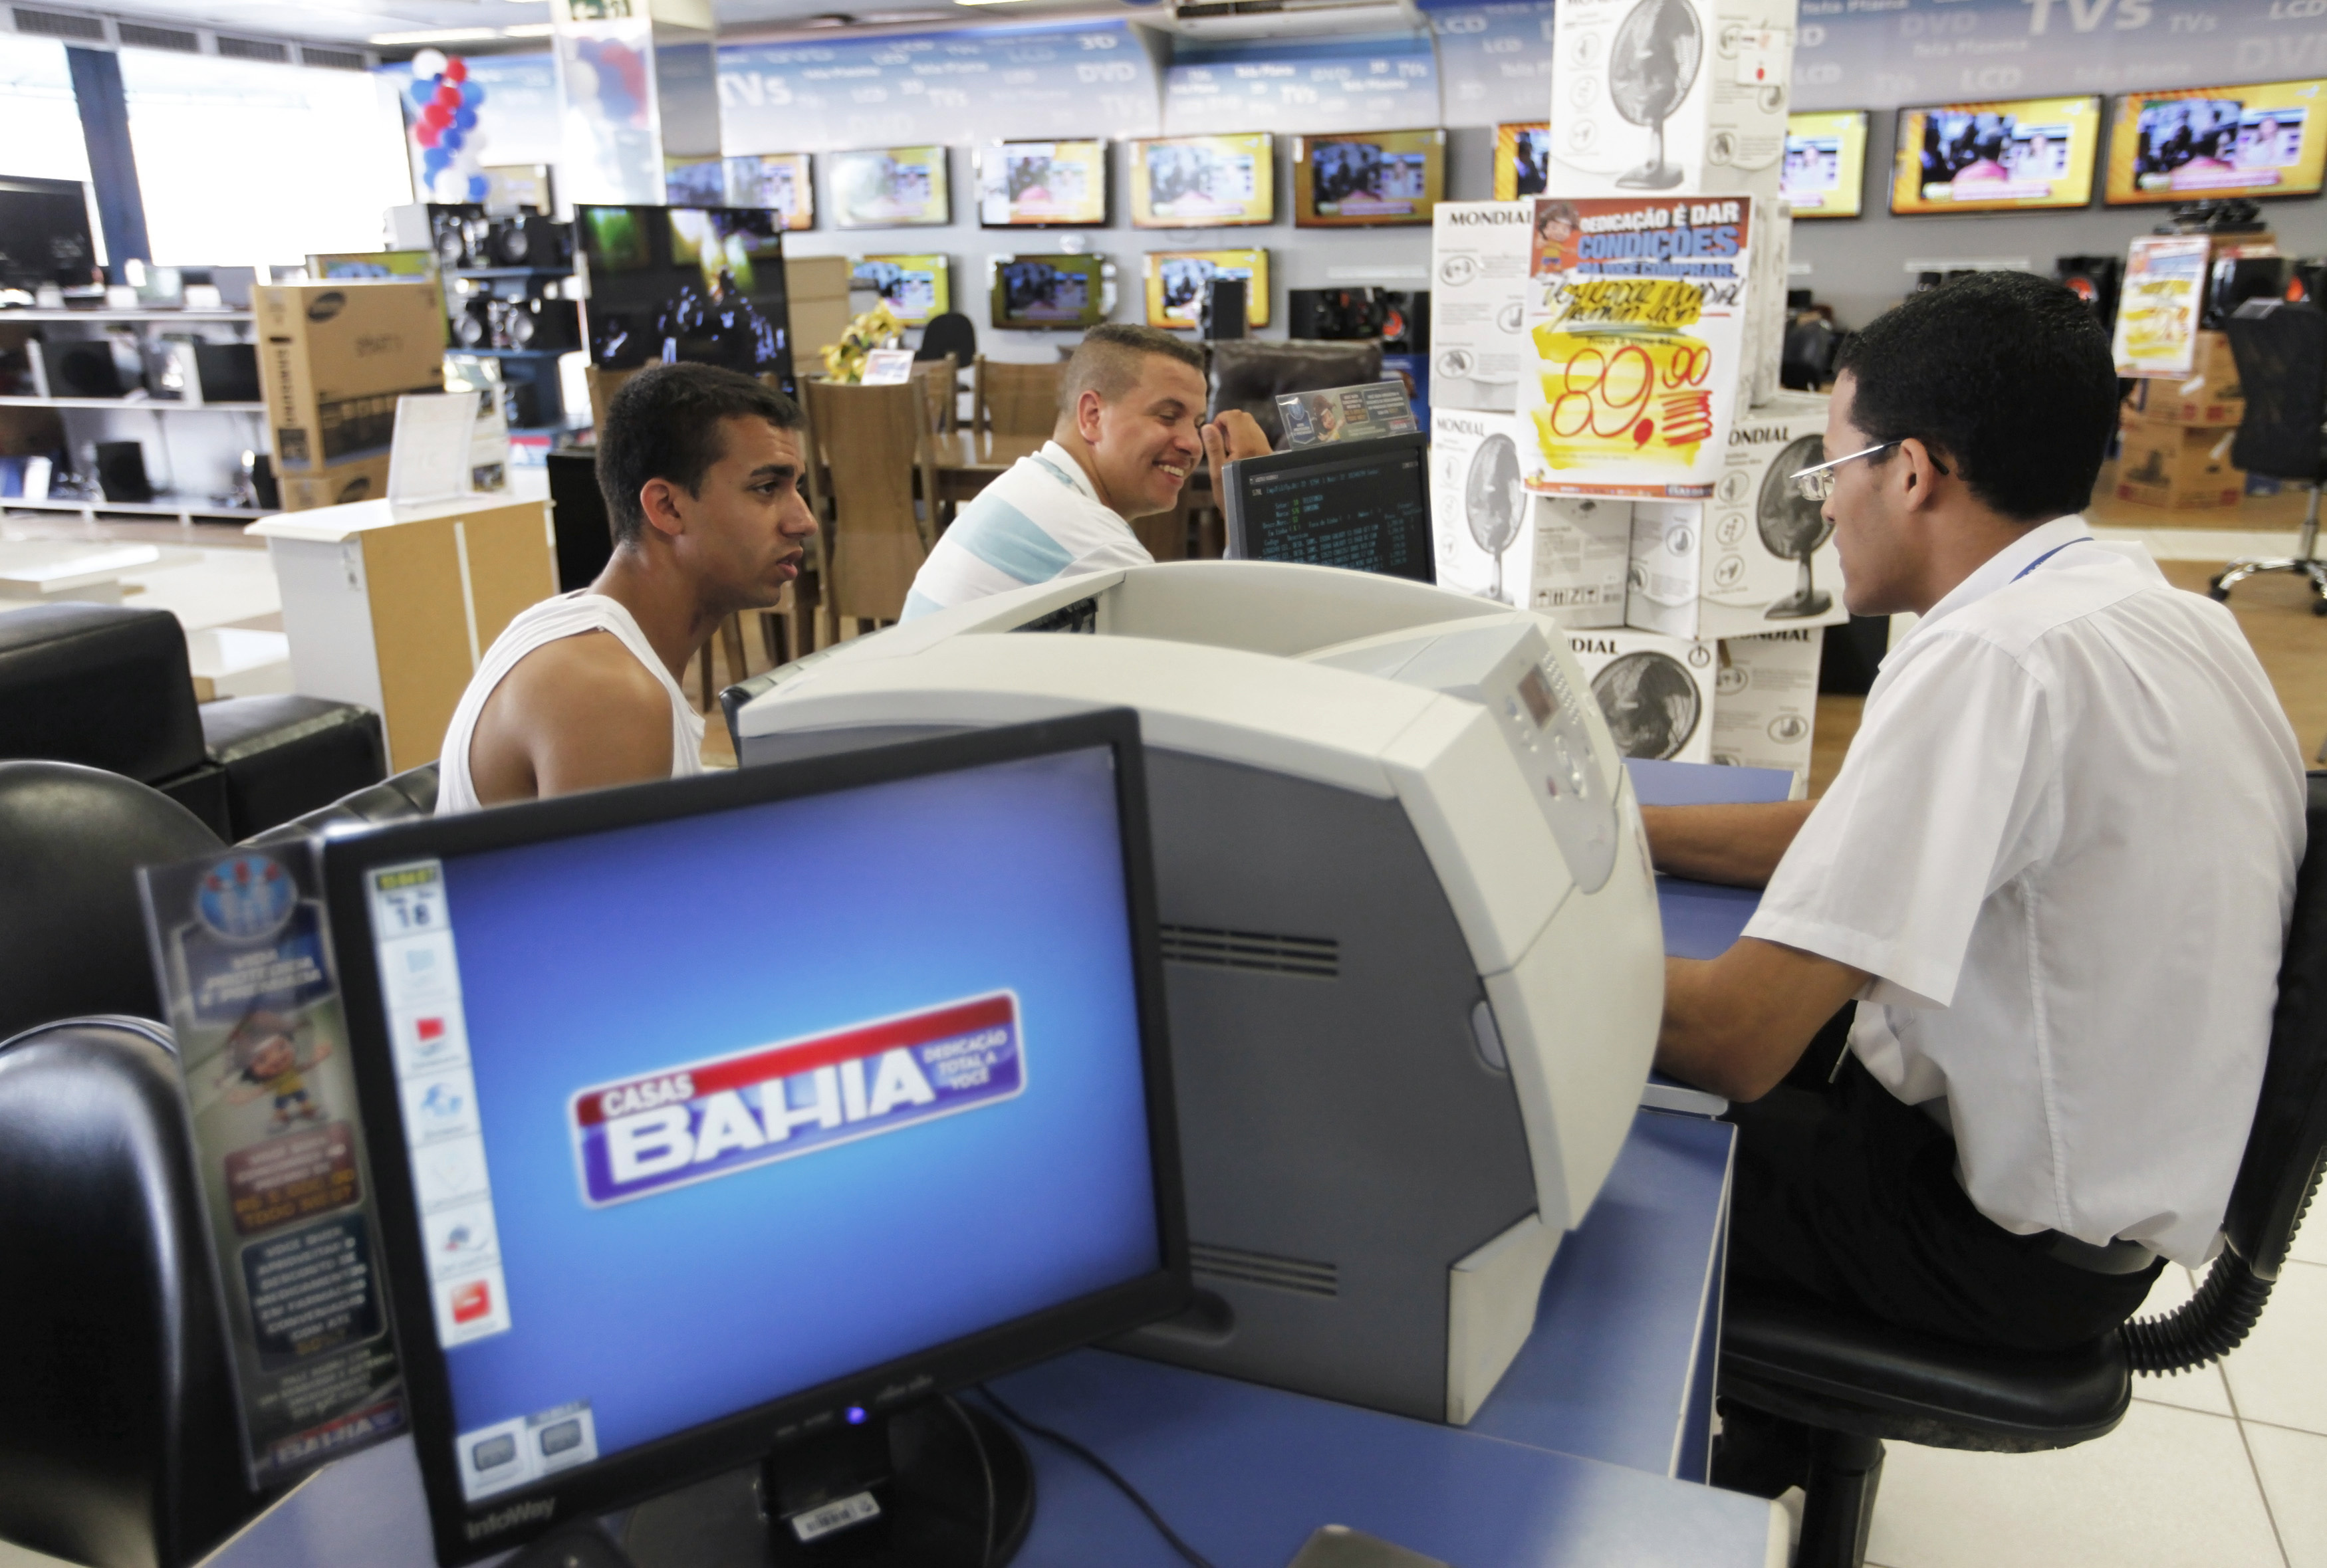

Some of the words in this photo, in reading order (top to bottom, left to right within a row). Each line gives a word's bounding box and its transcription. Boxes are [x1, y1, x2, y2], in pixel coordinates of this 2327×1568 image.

[2019, 0, 2153, 35] TVs
[2269, 0, 2327, 20] LCD
[1431, 15, 1488, 35] LCD
[1900, 12, 1979, 38] DVD
[2169, 13, 2217, 33] TVs
[1580, 207, 1669, 233] DEDICAÇÃO
[1672, 203, 1688, 227] É
[1690, 201, 1741, 225] DAR
[1578, 225, 1741, 262] CONDIÇÕES
[1437, 417, 1486, 437] MONDIAL
[1728, 426, 1790, 446] ONDIAL
[1570, 638, 1618, 654] DIAL
[923, 1029, 1008, 1063] DEDICAÇÃO
[939, 1053, 981, 1075] TOTAL
[985, 1050, 997, 1065] A
[949, 1066, 990, 1090] VOCÊ
[601, 1071, 695, 1118] CASAS
[605, 1046, 937, 1186] BAHIA
